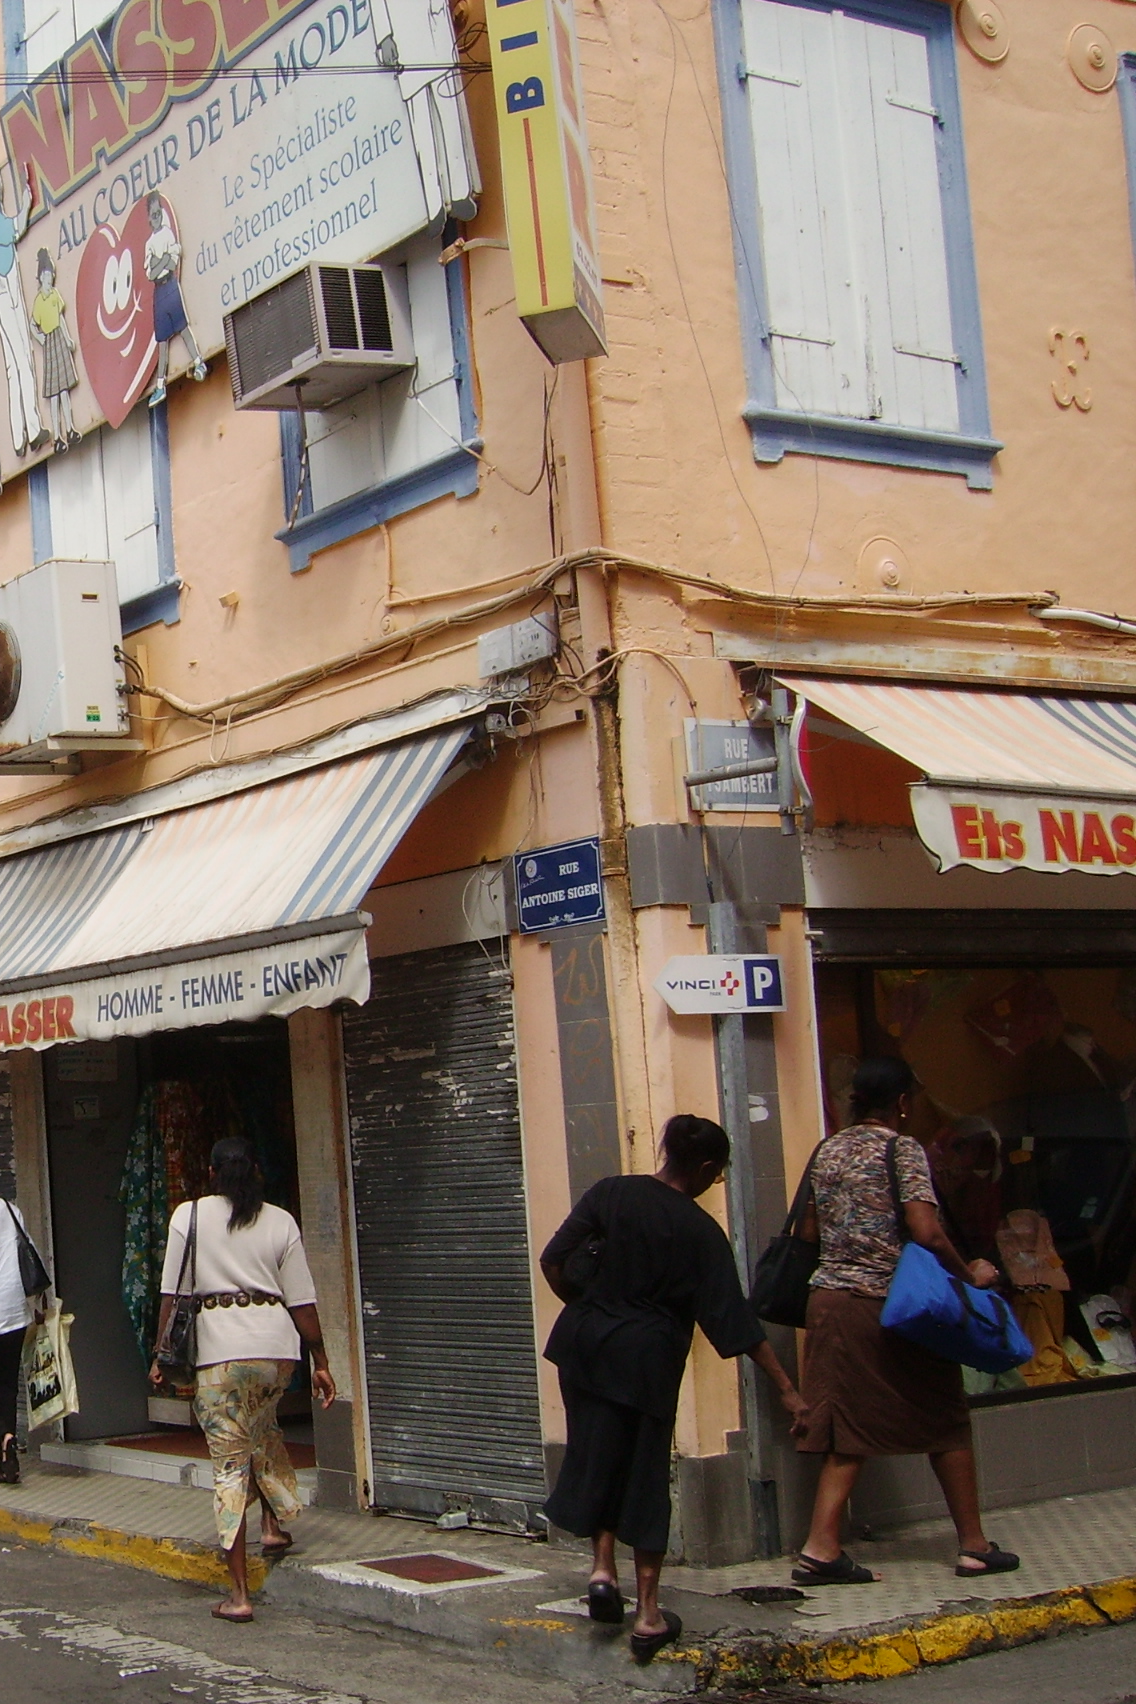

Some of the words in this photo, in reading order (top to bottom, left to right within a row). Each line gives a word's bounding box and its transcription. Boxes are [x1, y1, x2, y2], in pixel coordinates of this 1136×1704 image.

[496, 0, 545, 114] BI
[0, 0, 322, 228] NASS
[57, 203, 87, 260] AU
[92, 134, 180, 227] COEUR
[186, 98, 224, 161] DE
[229, 69, 268, 128] LA
[274, 0, 372, 96] MODE
[222, 174, 244, 208] Le
[250, 96, 357, 190] Spécialiste
[195, 241, 219, 275] du
[222, 174, 314, 256] vêtement
[319, 119, 403, 194] scolaire
[220, 273, 238, 307] et
[242, 177, 378, 300] professionnel
[724, 738, 748, 759] RUE
[558, 861, 580, 876] RUE
[949, 803, 1026, 861] Ets
[1037, 807, 1136, 868] NAS
[521, 889, 565, 909] ANTOINE
[567, 882, 599, 900] SIGER
[97, 984, 163, 1022] HOMME
[181, 970, 244, 1009] FEMME
[263, 953, 348, 998] ENFANT
[666, 980, 715, 990] VINCI
[752, 966, 773, 999] P
